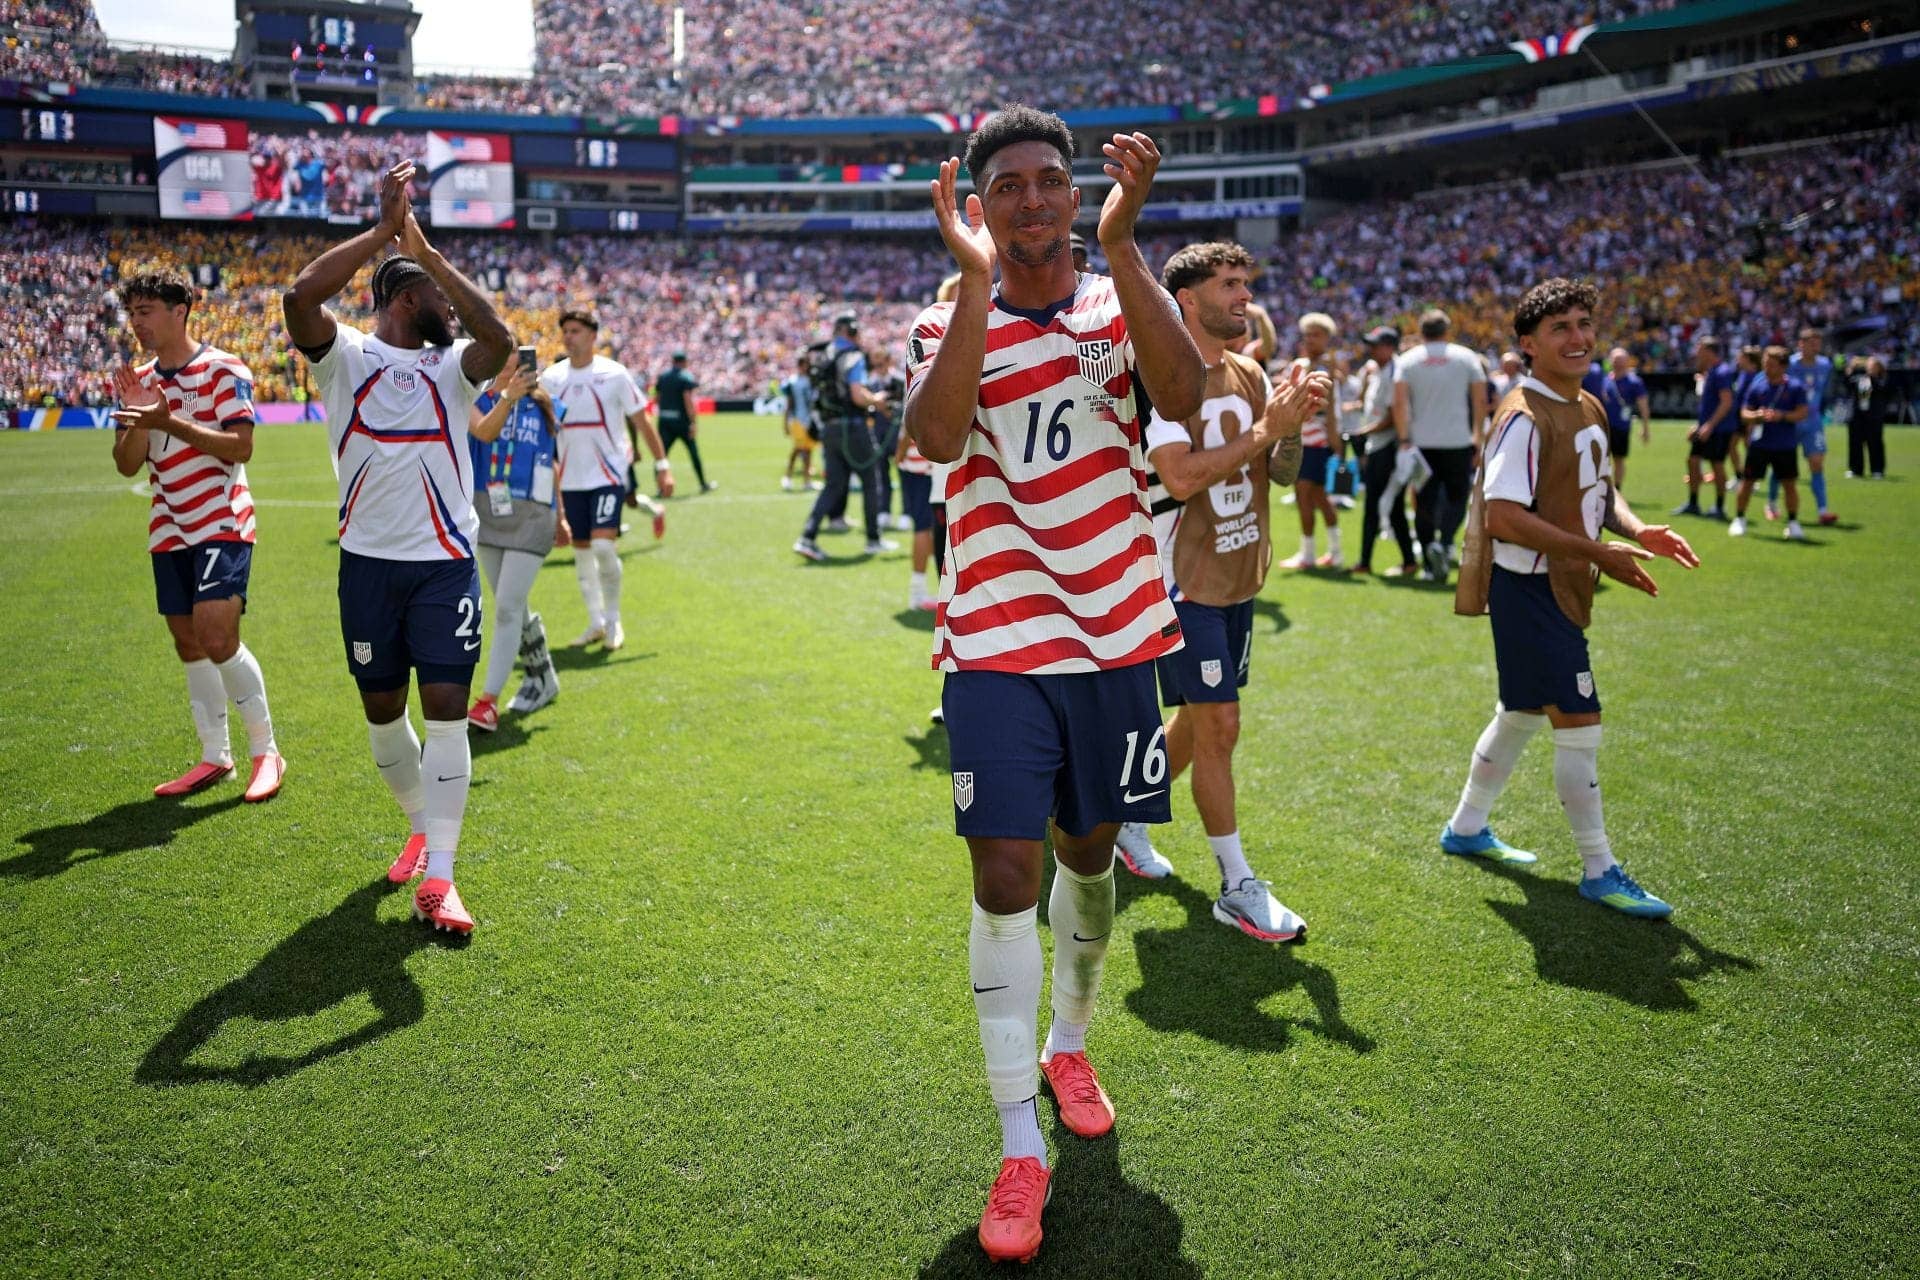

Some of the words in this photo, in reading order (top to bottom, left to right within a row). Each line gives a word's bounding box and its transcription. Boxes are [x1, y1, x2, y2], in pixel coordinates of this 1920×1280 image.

[184, 156, 222, 180] USA
[1079, 342, 1110, 360] USA
[395, 372, 413, 383] USA
[183, 393, 197, 402] USA
[1024, 399, 1074, 463] 16
[596, 494, 617, 517] 18
[1224, 490, 1245, 505] FIF
[202, 548, 221, 580] 7
[1203, 662, 1219, 672] USA
[1119, 725, 1167, 787] 16
[955, 773, 972, 789] USA
